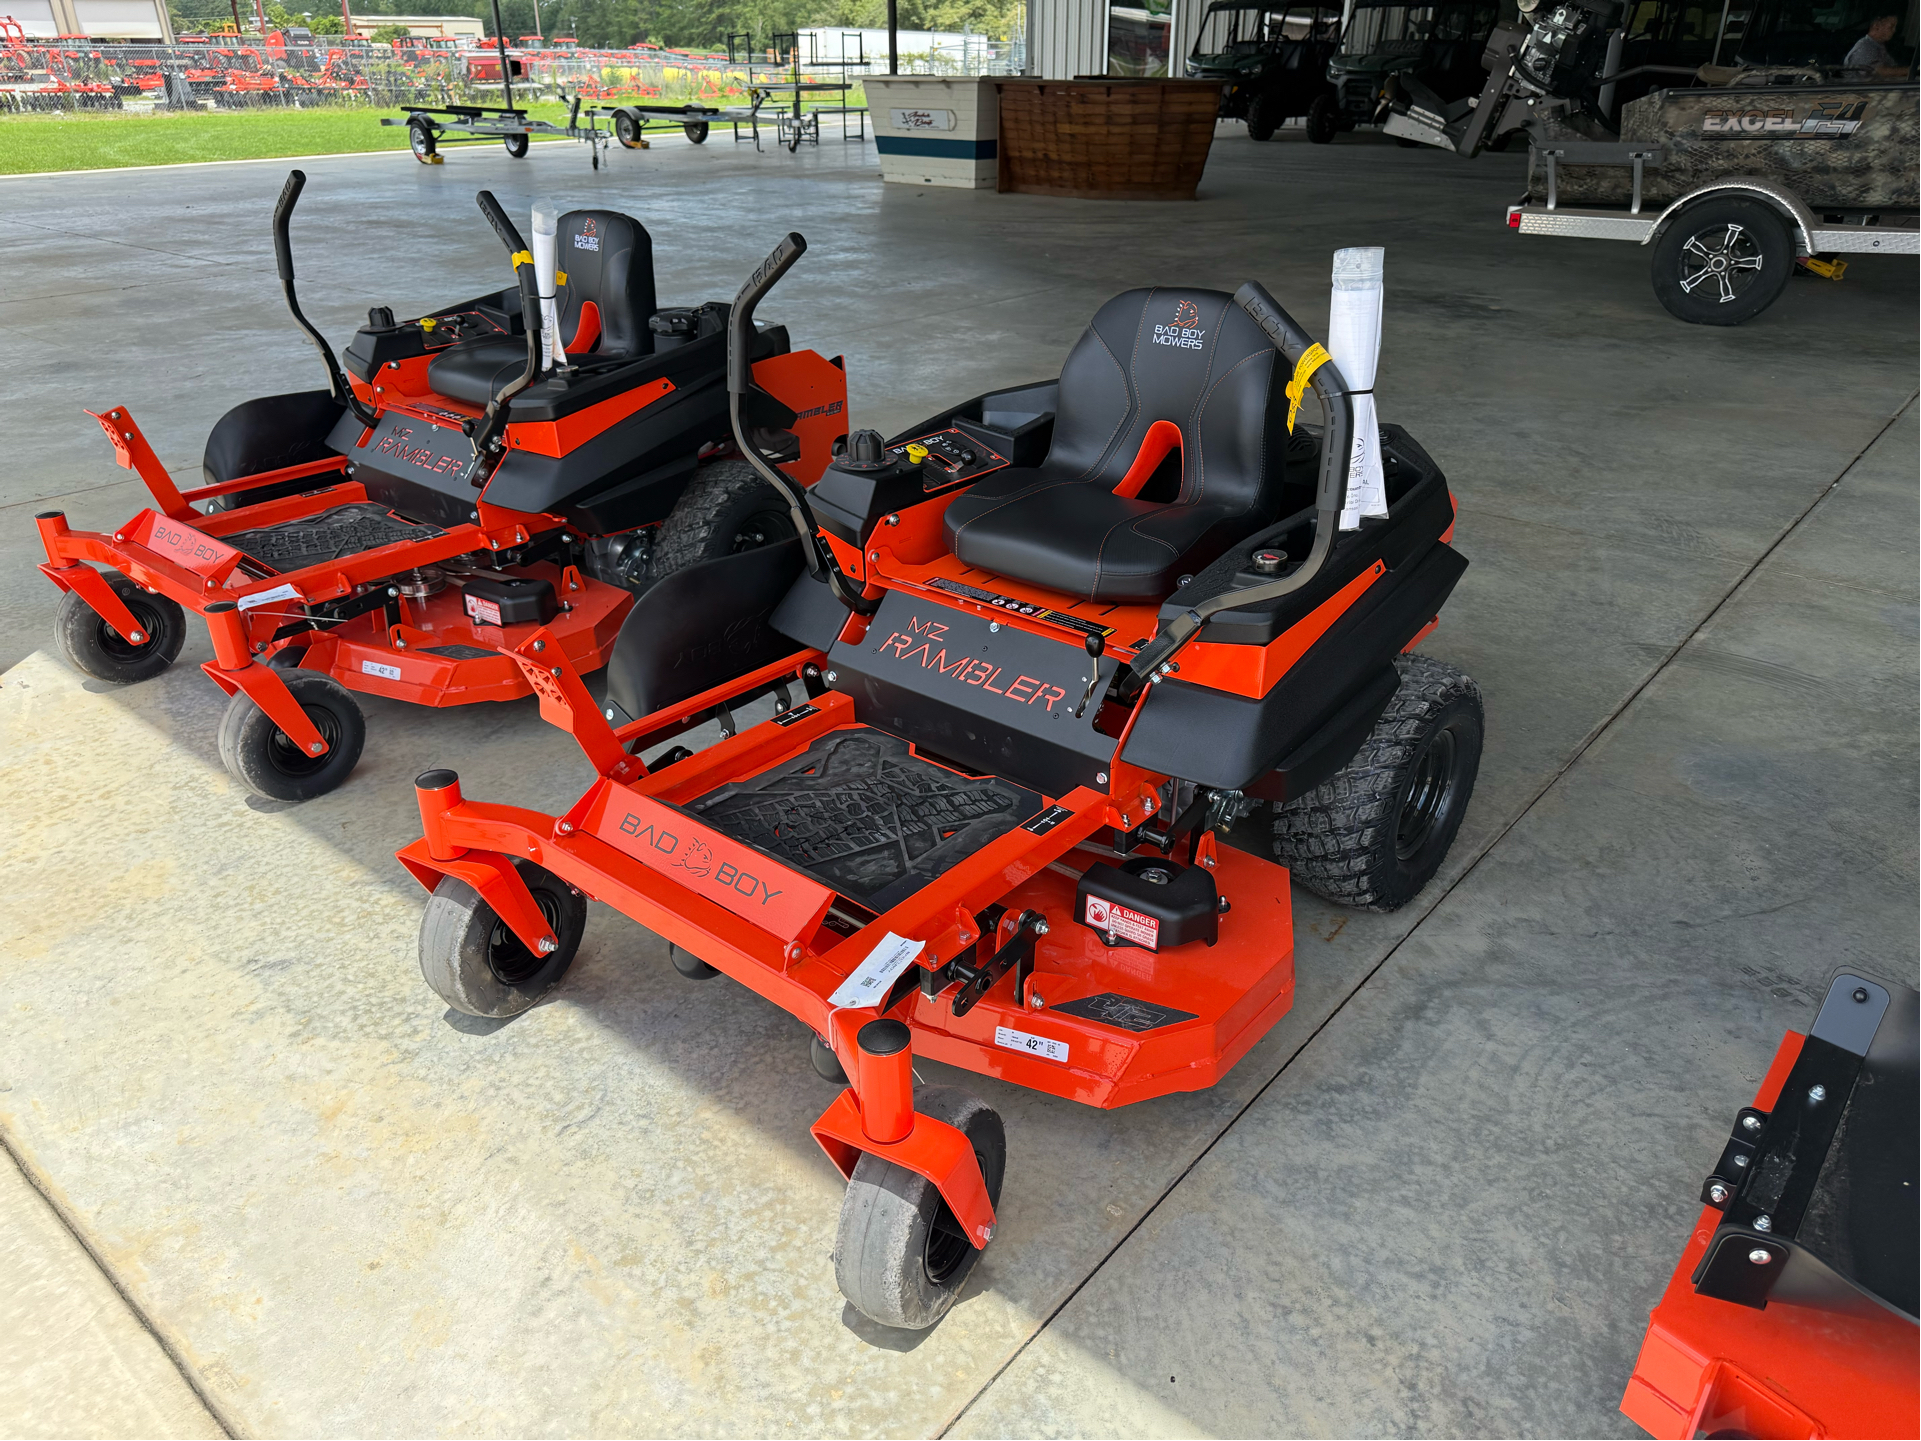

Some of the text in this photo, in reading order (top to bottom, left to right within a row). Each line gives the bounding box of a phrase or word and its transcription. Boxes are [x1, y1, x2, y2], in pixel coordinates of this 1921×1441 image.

[1702, 101, 1868, 134] EXCEL F4
[574, 234, 600, 245] BAD BOY
[574, 241, 599, 252] MOWERS
[752, 244, 783, 287] BAD
[1154, 324, 1206, 339] BAD BOY
[1243, 296, 1302, 353] BOY
[1152, 333, 1204, 350] MOWERS
[796, 400, 844, 420] AMBLER
[391, 425, 413, 441] MZ
[923, 435, 944, 445] BOY
[374, 437, 463, 477] RAMBLER
[154, 526, 224, 564] BAD BOY
[907, 615, 950, 642] MZ
[879, 631, 1066, 712] RAMBLER
[619, 813, 783, 905] BAD BOY
[1123, 910, 1156, 928] DANGER
